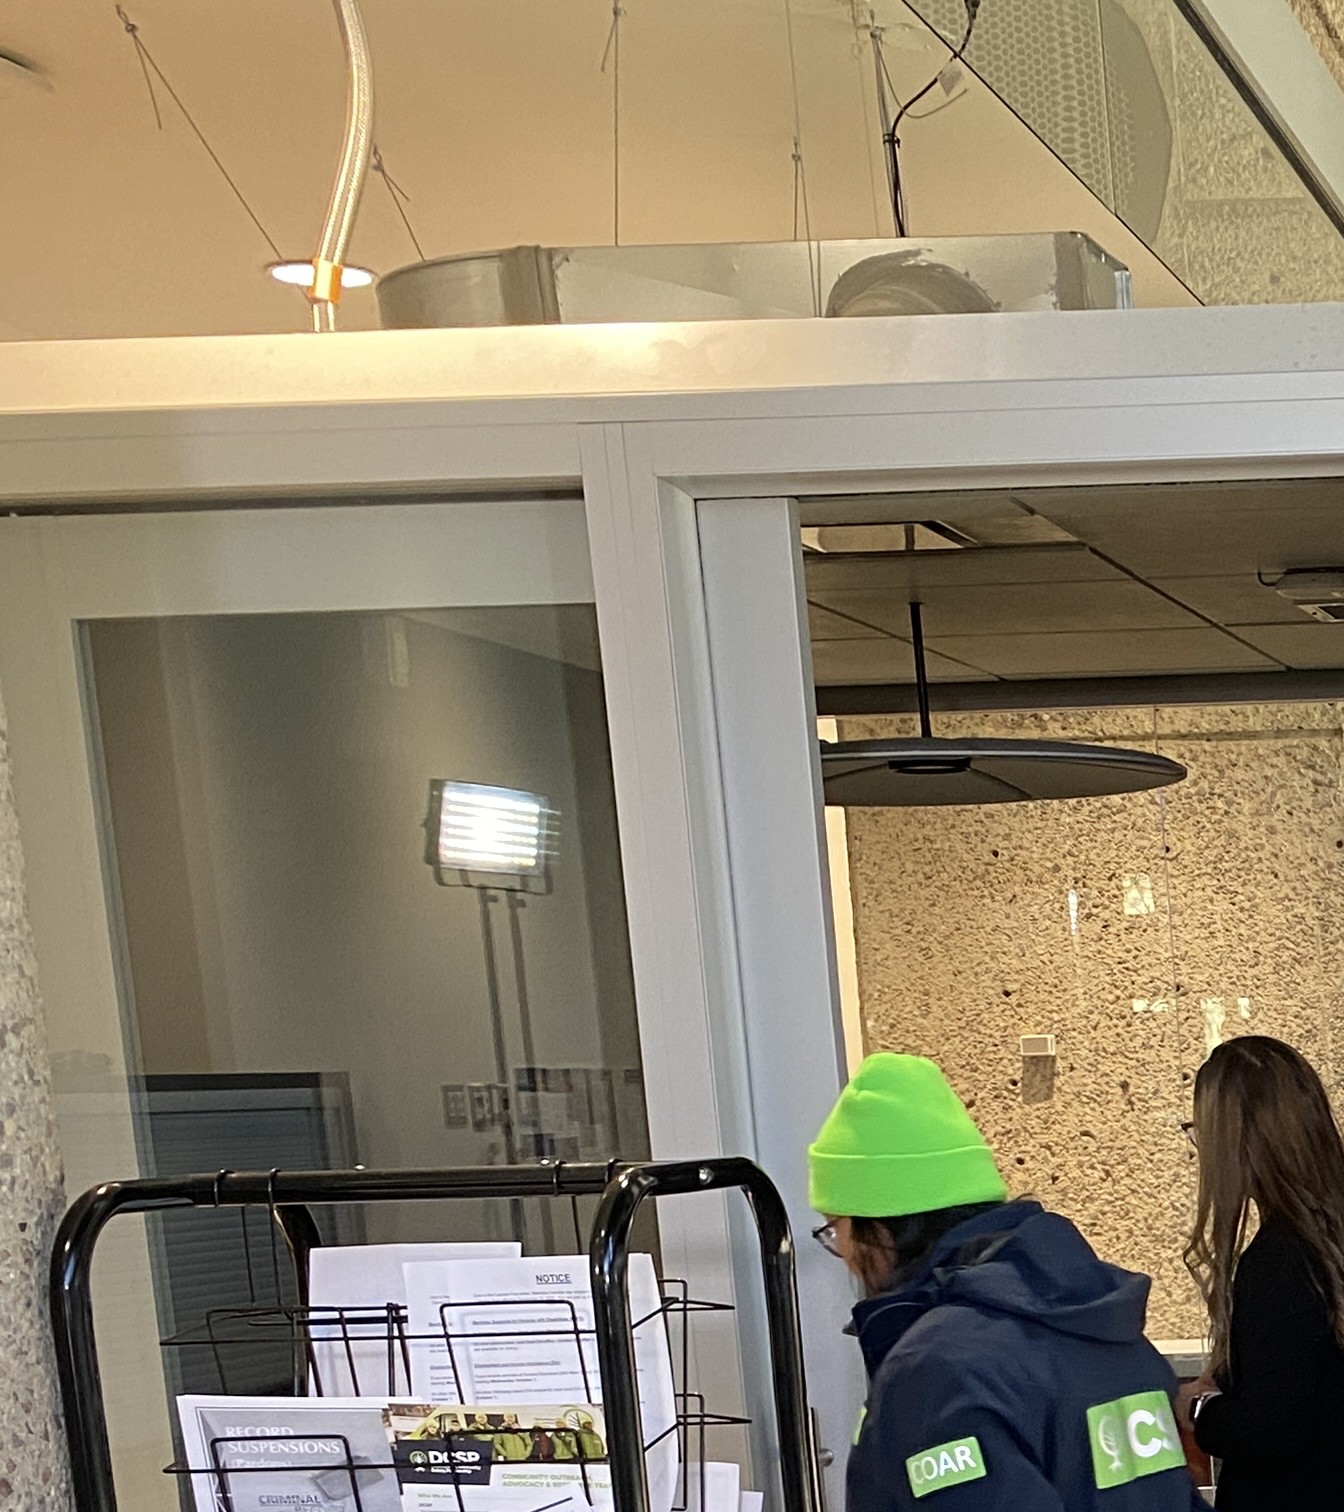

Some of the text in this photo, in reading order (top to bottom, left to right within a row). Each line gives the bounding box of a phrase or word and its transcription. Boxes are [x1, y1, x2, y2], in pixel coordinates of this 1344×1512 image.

[536, 1273, 572, 1284] NOTICE
[225, 1426, 294, 1437] RECORD
[227, 1441, 340, 1454] SUSPENSIONS
[428, 1451, 481, 1463] DCSP
[911, 1445, 976, 1485] COAR
[259, 1495, 321, 1505] CRIMINAL
